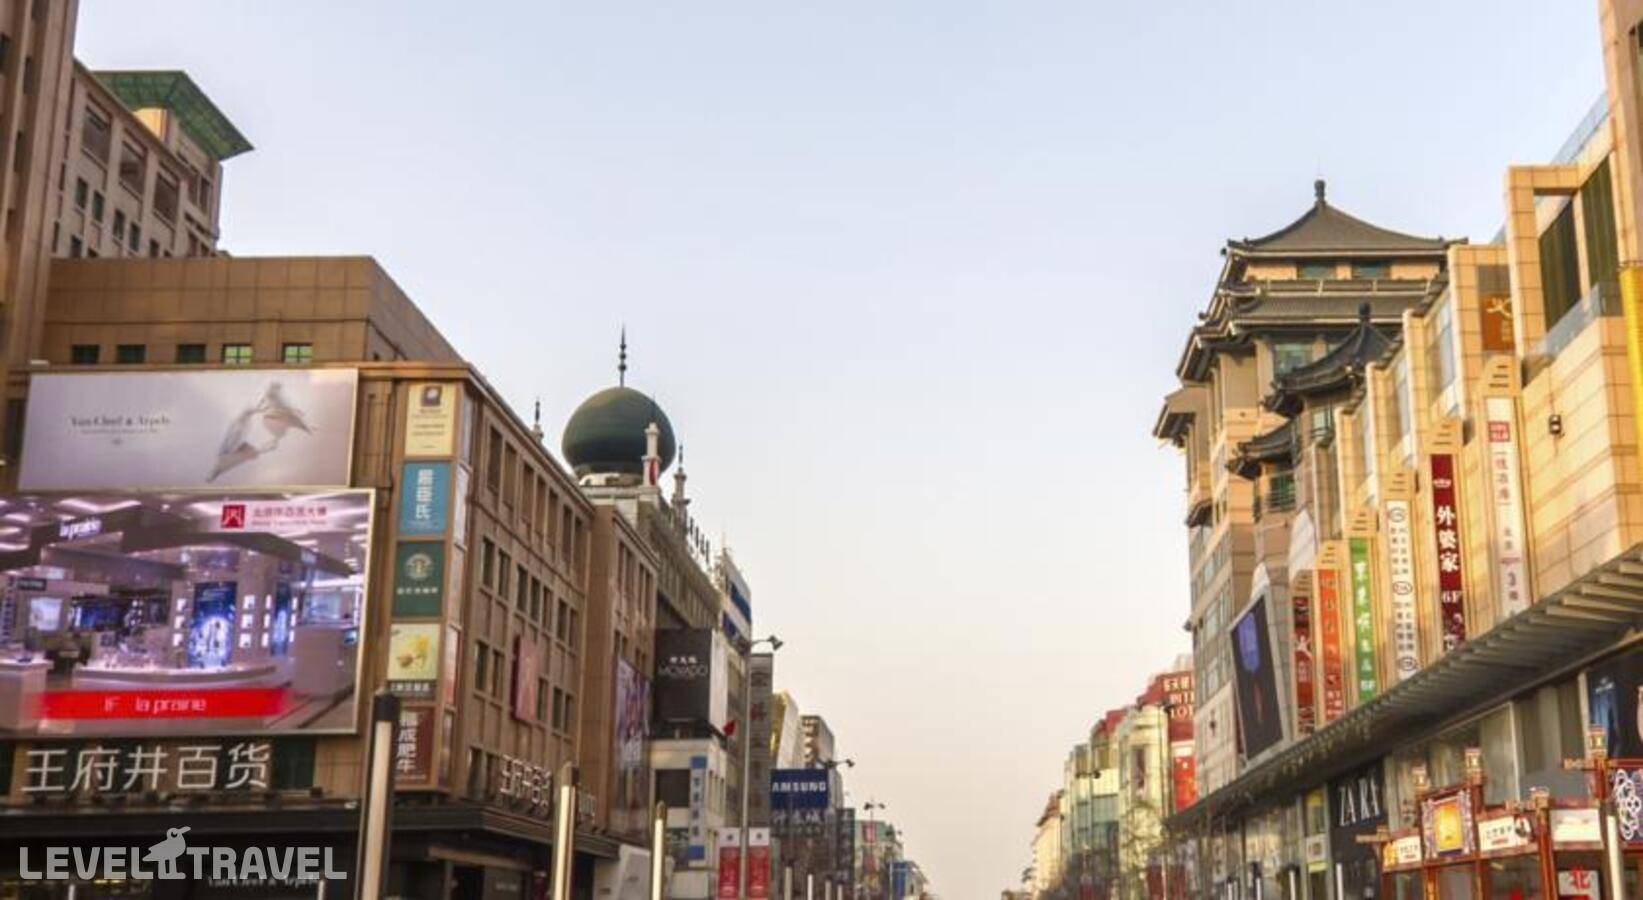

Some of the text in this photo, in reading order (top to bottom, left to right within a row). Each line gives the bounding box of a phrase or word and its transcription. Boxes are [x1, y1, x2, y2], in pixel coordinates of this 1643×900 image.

[21, 744, 273, 793] 王府井百货
[771, 782, 827, 793] AMSUNG
